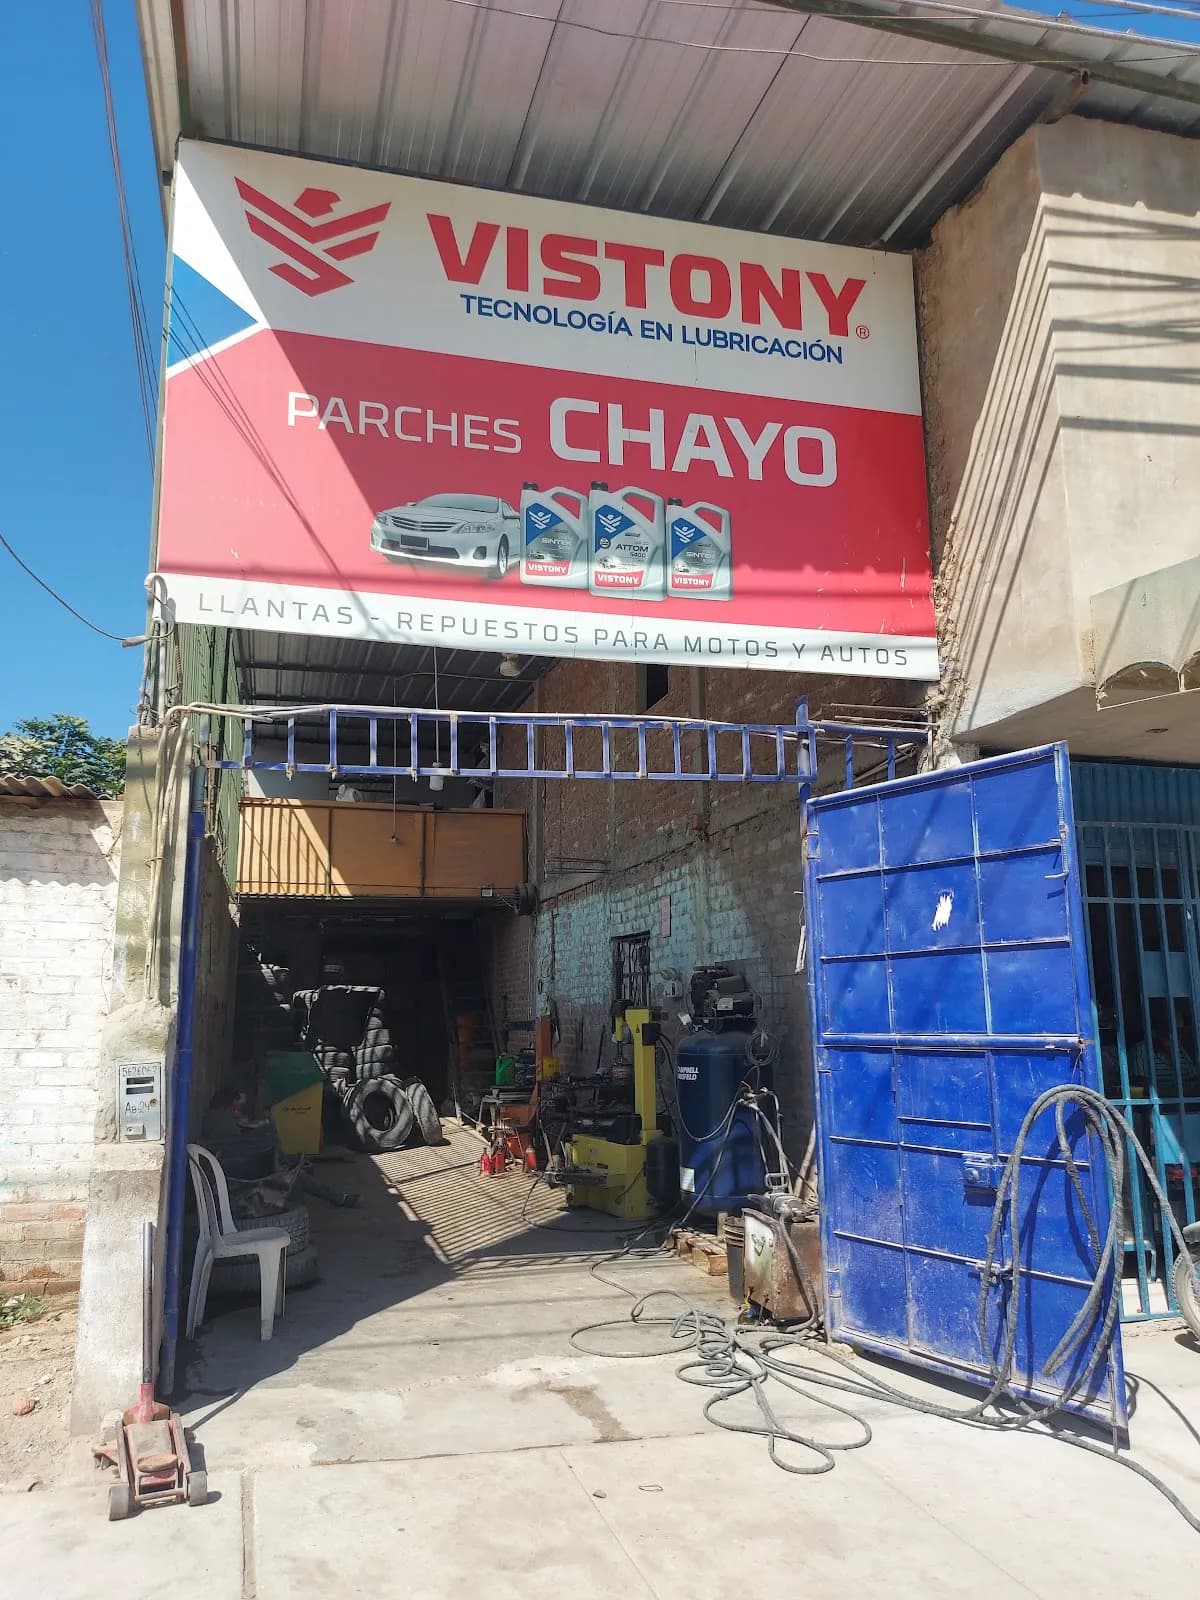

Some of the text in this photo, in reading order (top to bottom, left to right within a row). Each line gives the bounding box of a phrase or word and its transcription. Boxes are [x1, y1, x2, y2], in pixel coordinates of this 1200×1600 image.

[426, 213, 867, 337] VISTONY
[460, 294, 843, 365] TECNOLOGÍA EN LUBRICACIÓN
[287, 391, 838, 487] PARCHES CHAYO
[615, 543, 649, 552] ATTOM
[528, 563, 567, 574] VISTONY
[597, 573, 640, 585] VISTONY
[673, 576, 711, 586] VISTONY
[199, 593, 353, 625] LLANTAS
[397, 611, 579, 643] REPUESTOS
[594, 628, 669, 650] PARA
[684, 635, 778, 658] MOTOS
[792, 642, 807, 660] Y
[820, 644, 908, 666] AUTOS
